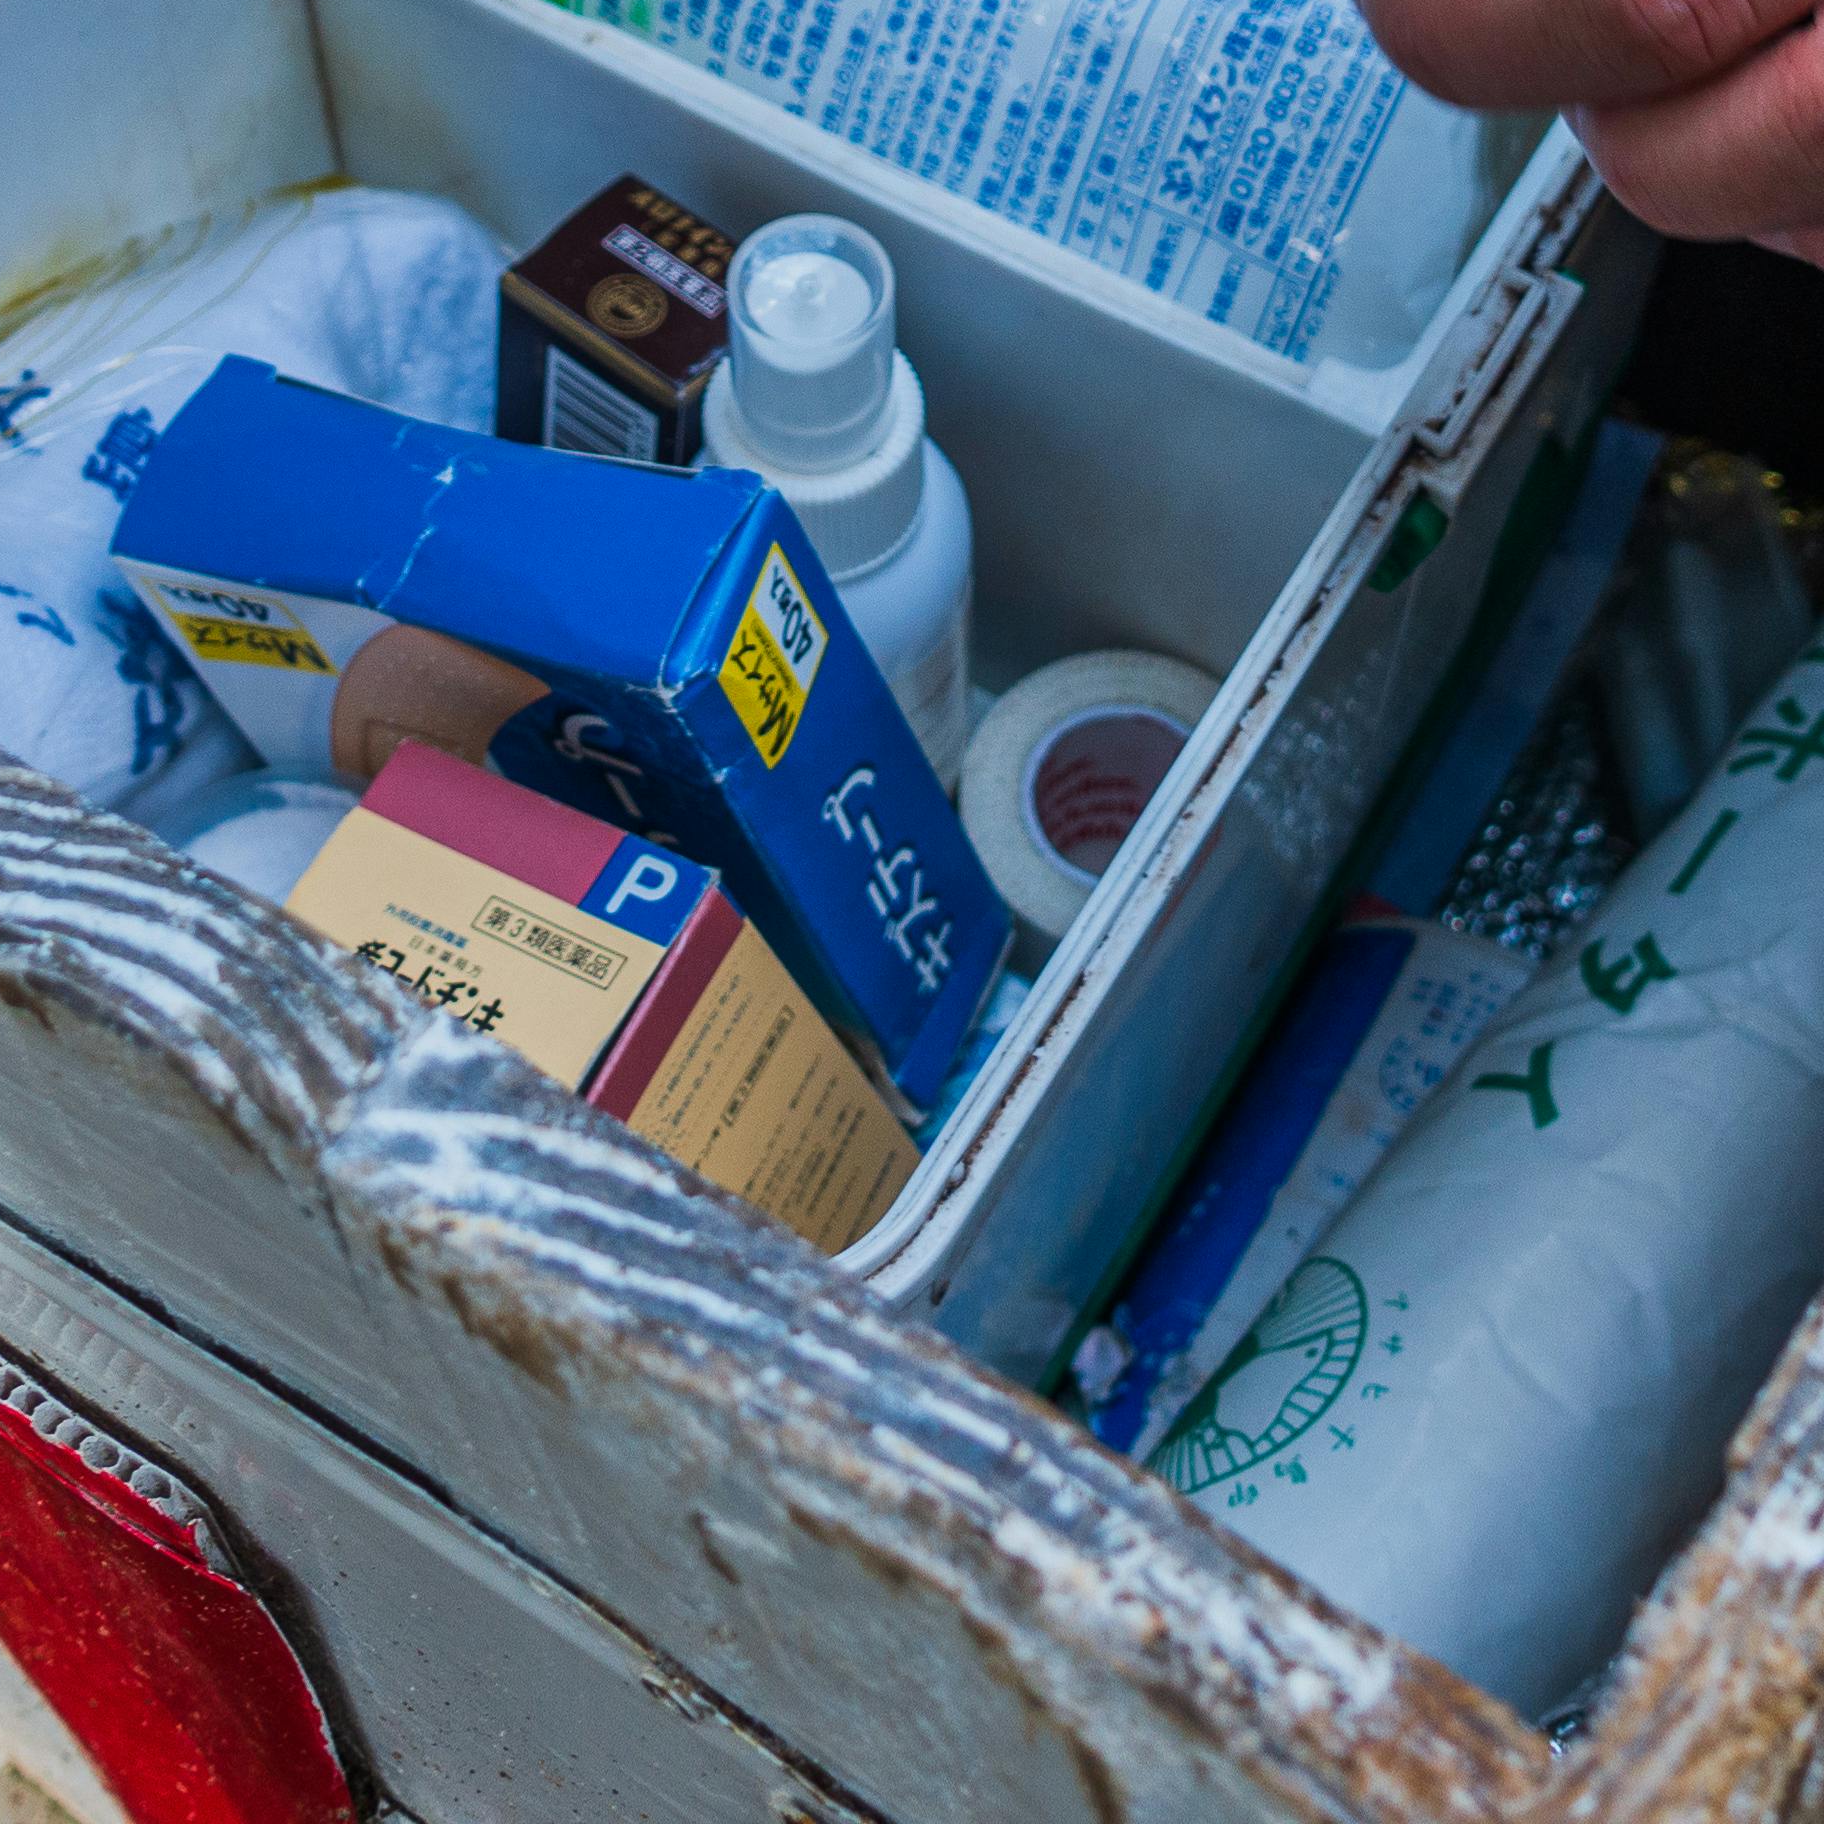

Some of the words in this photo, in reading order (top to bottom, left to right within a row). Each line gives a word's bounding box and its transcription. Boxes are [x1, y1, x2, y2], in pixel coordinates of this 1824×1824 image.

[605, 854, 677, 914] P
[821, 767, 954, 996] キズテープ
[482, 906, 619, 980] 第3類医薬品
